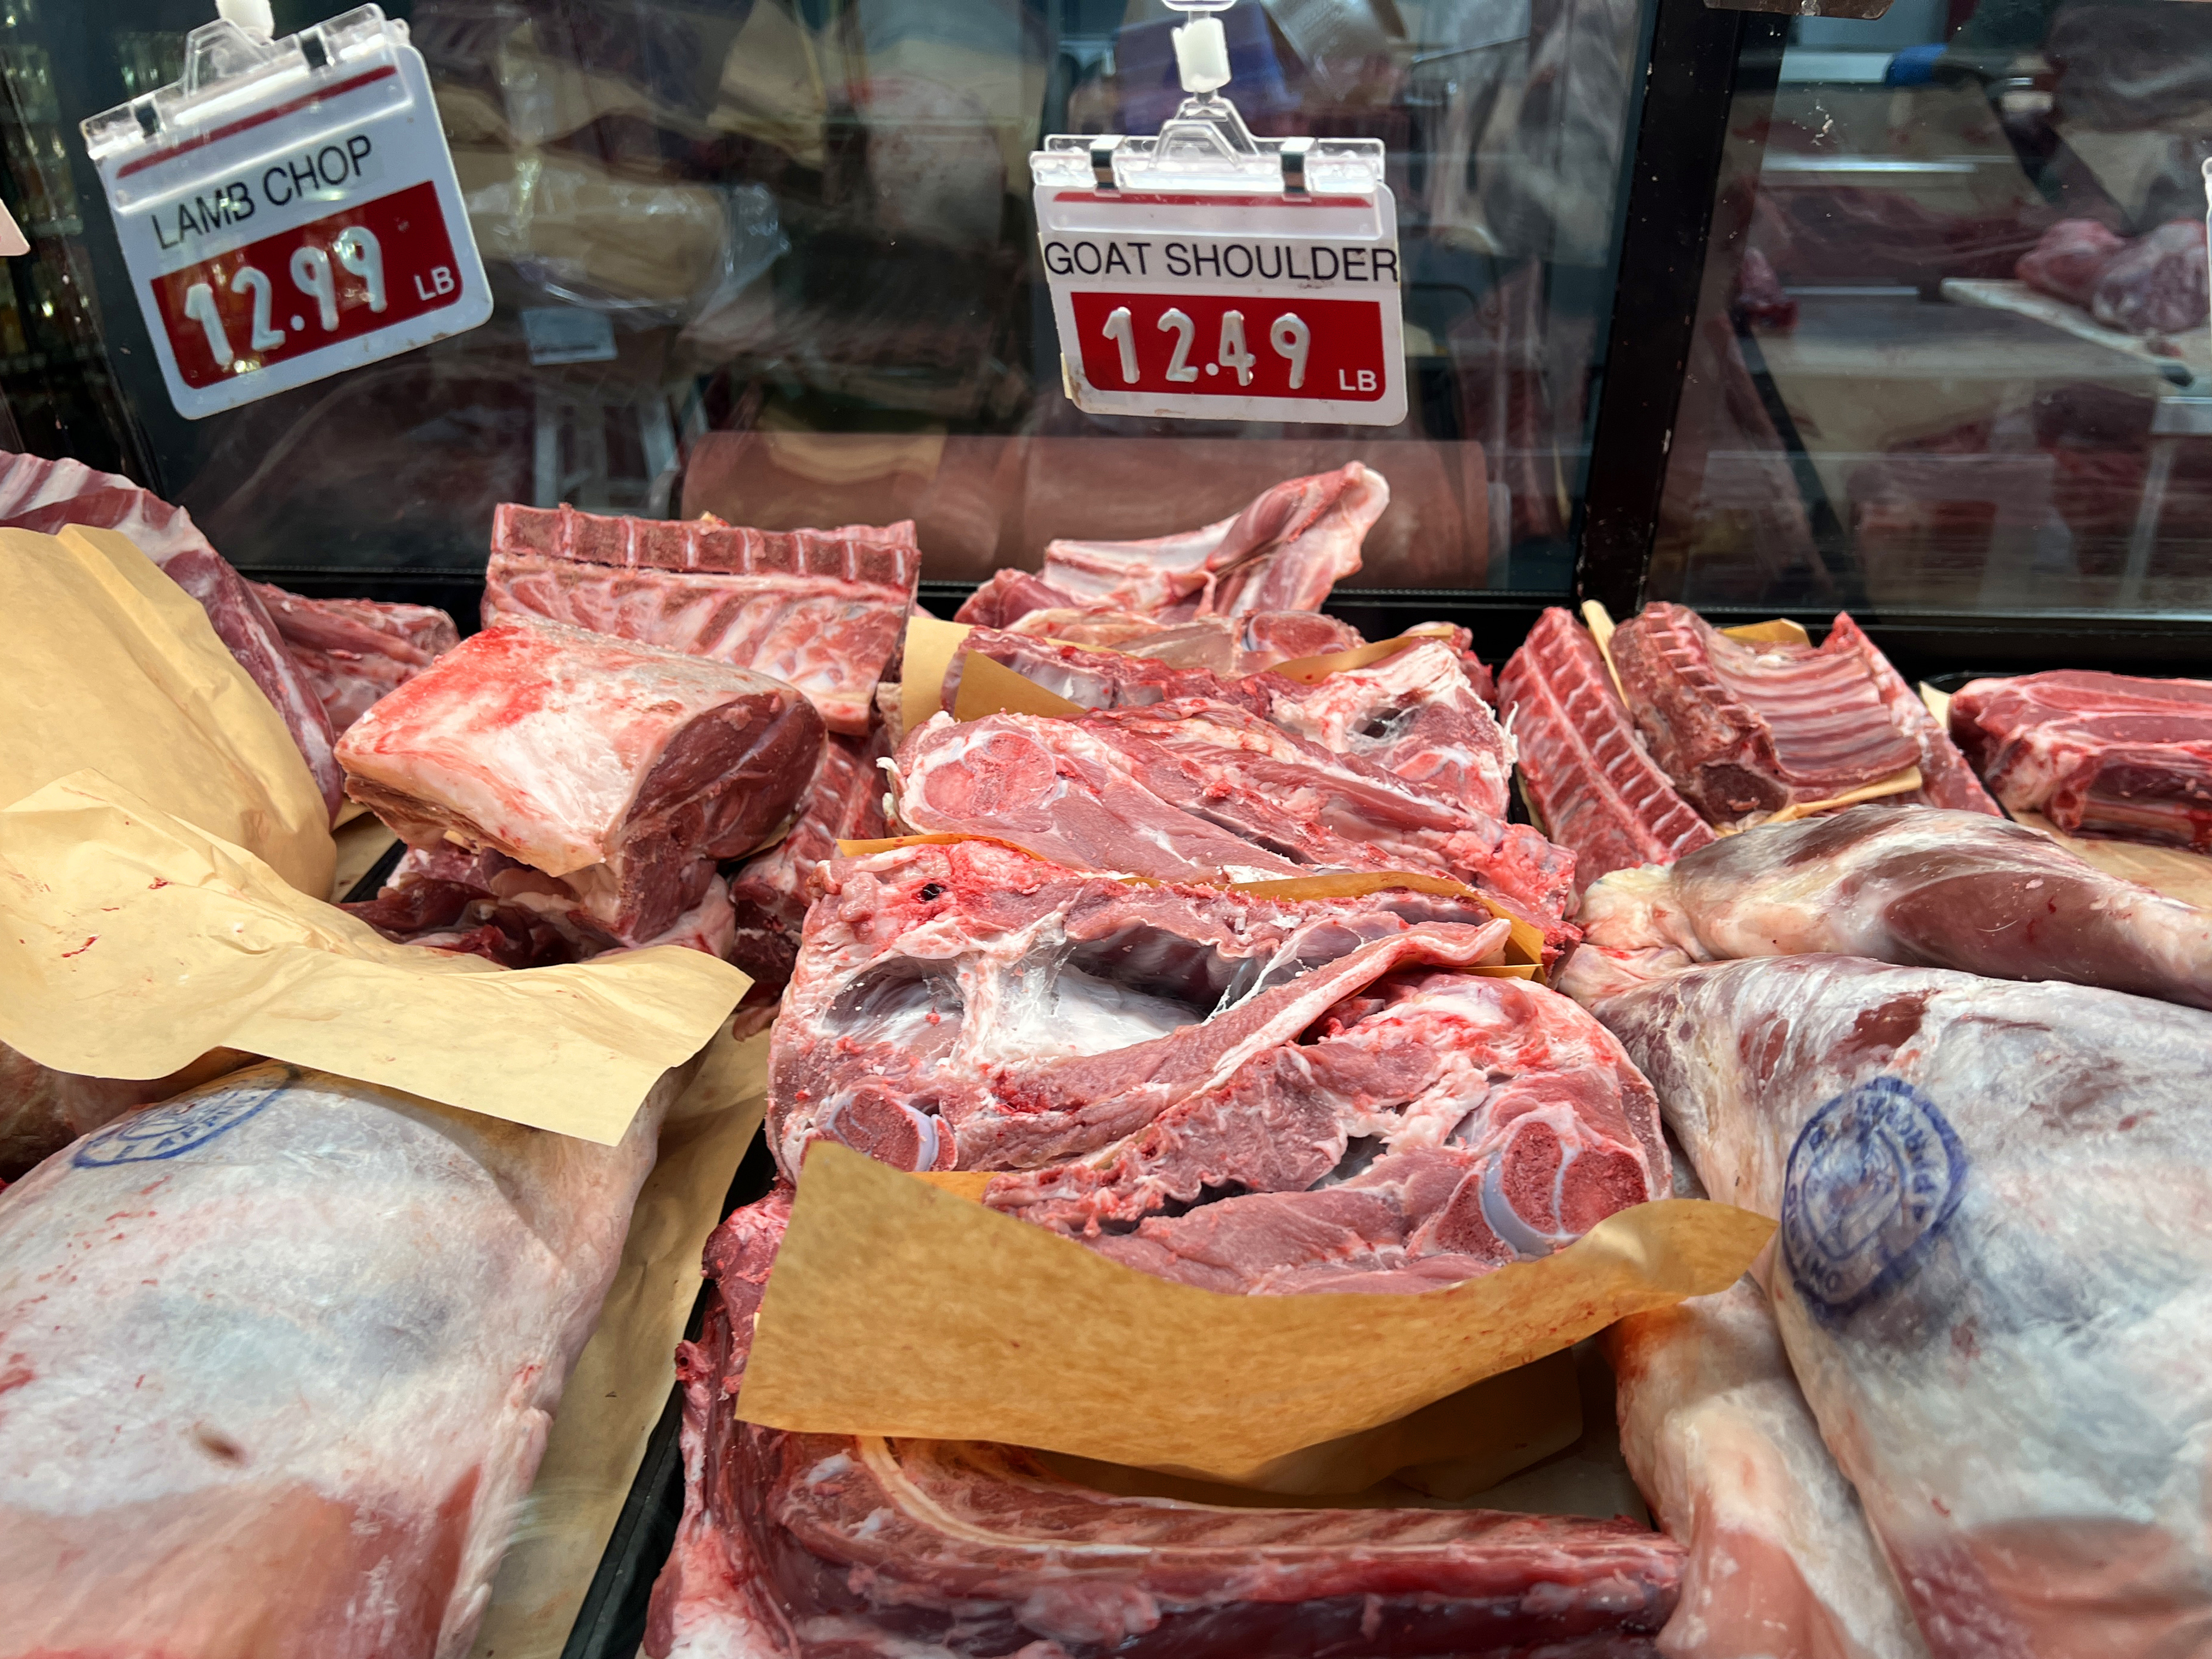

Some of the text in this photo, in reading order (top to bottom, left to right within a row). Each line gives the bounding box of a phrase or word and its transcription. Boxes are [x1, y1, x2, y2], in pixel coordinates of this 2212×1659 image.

[152, 134, 372, 250] LAMB CHOP
[184, 226, 455, 367] 12.99 LB
[1044, 241, 1398, 283] GOAT SHOULDER
[1102, 306, 1377, 391] 12.49 LB
